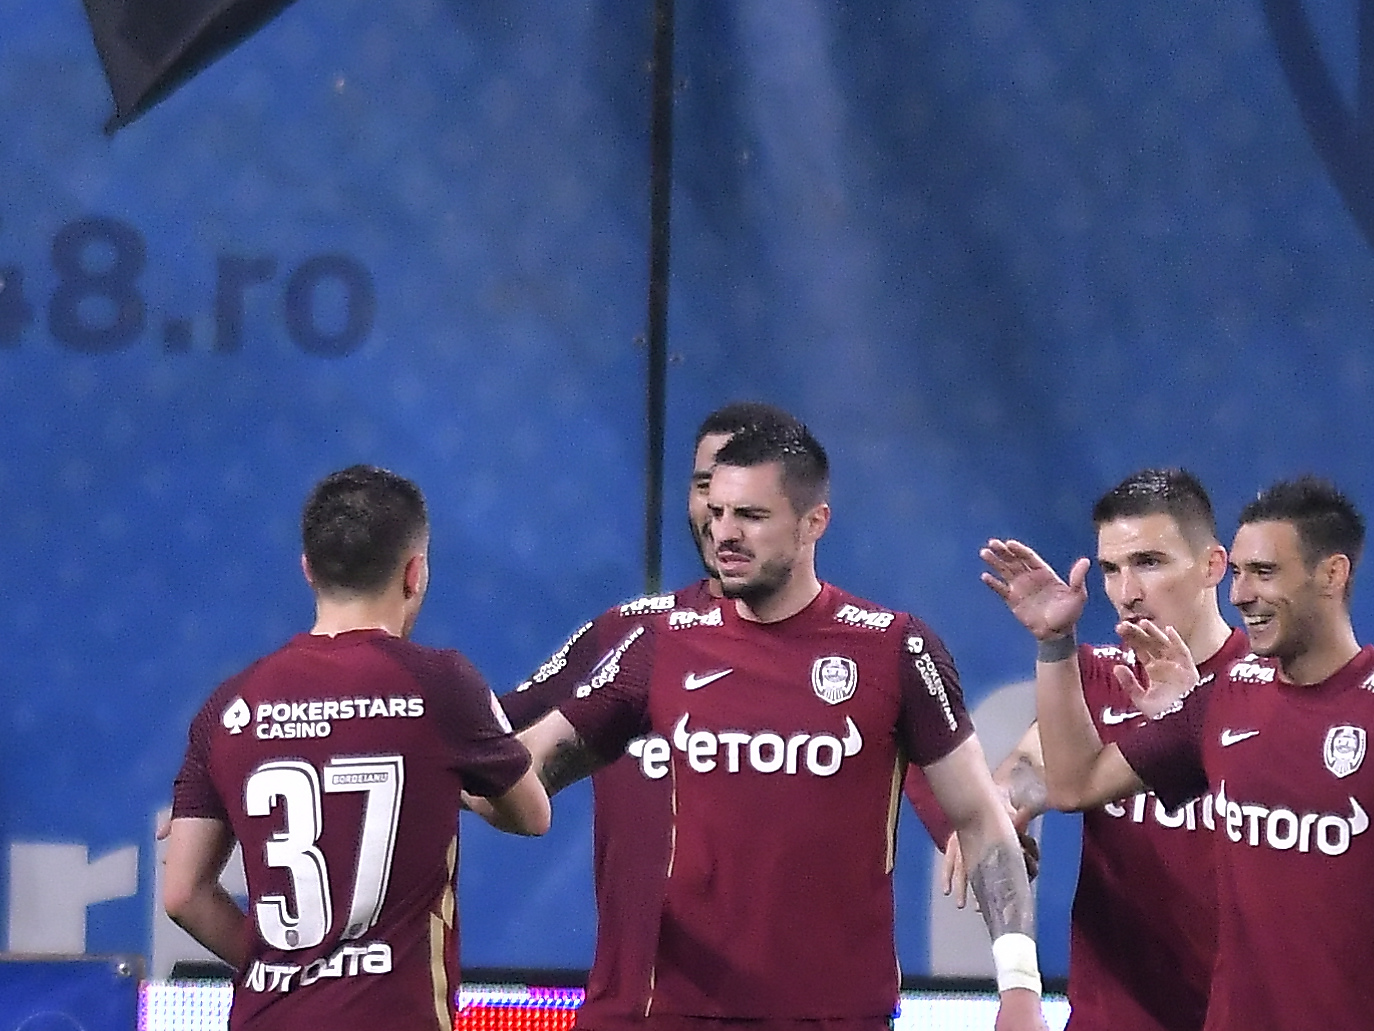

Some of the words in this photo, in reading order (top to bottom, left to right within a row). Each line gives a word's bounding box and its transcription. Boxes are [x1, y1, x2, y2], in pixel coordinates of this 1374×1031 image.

[0, 214, 378, 360] 8.ro
[836, 604, 895, 628] RMB
[256, 698, 424, 722] POKERSTARS
[256, 720, 331, 739] CASINO
[247, 756, 404, 951] 37
